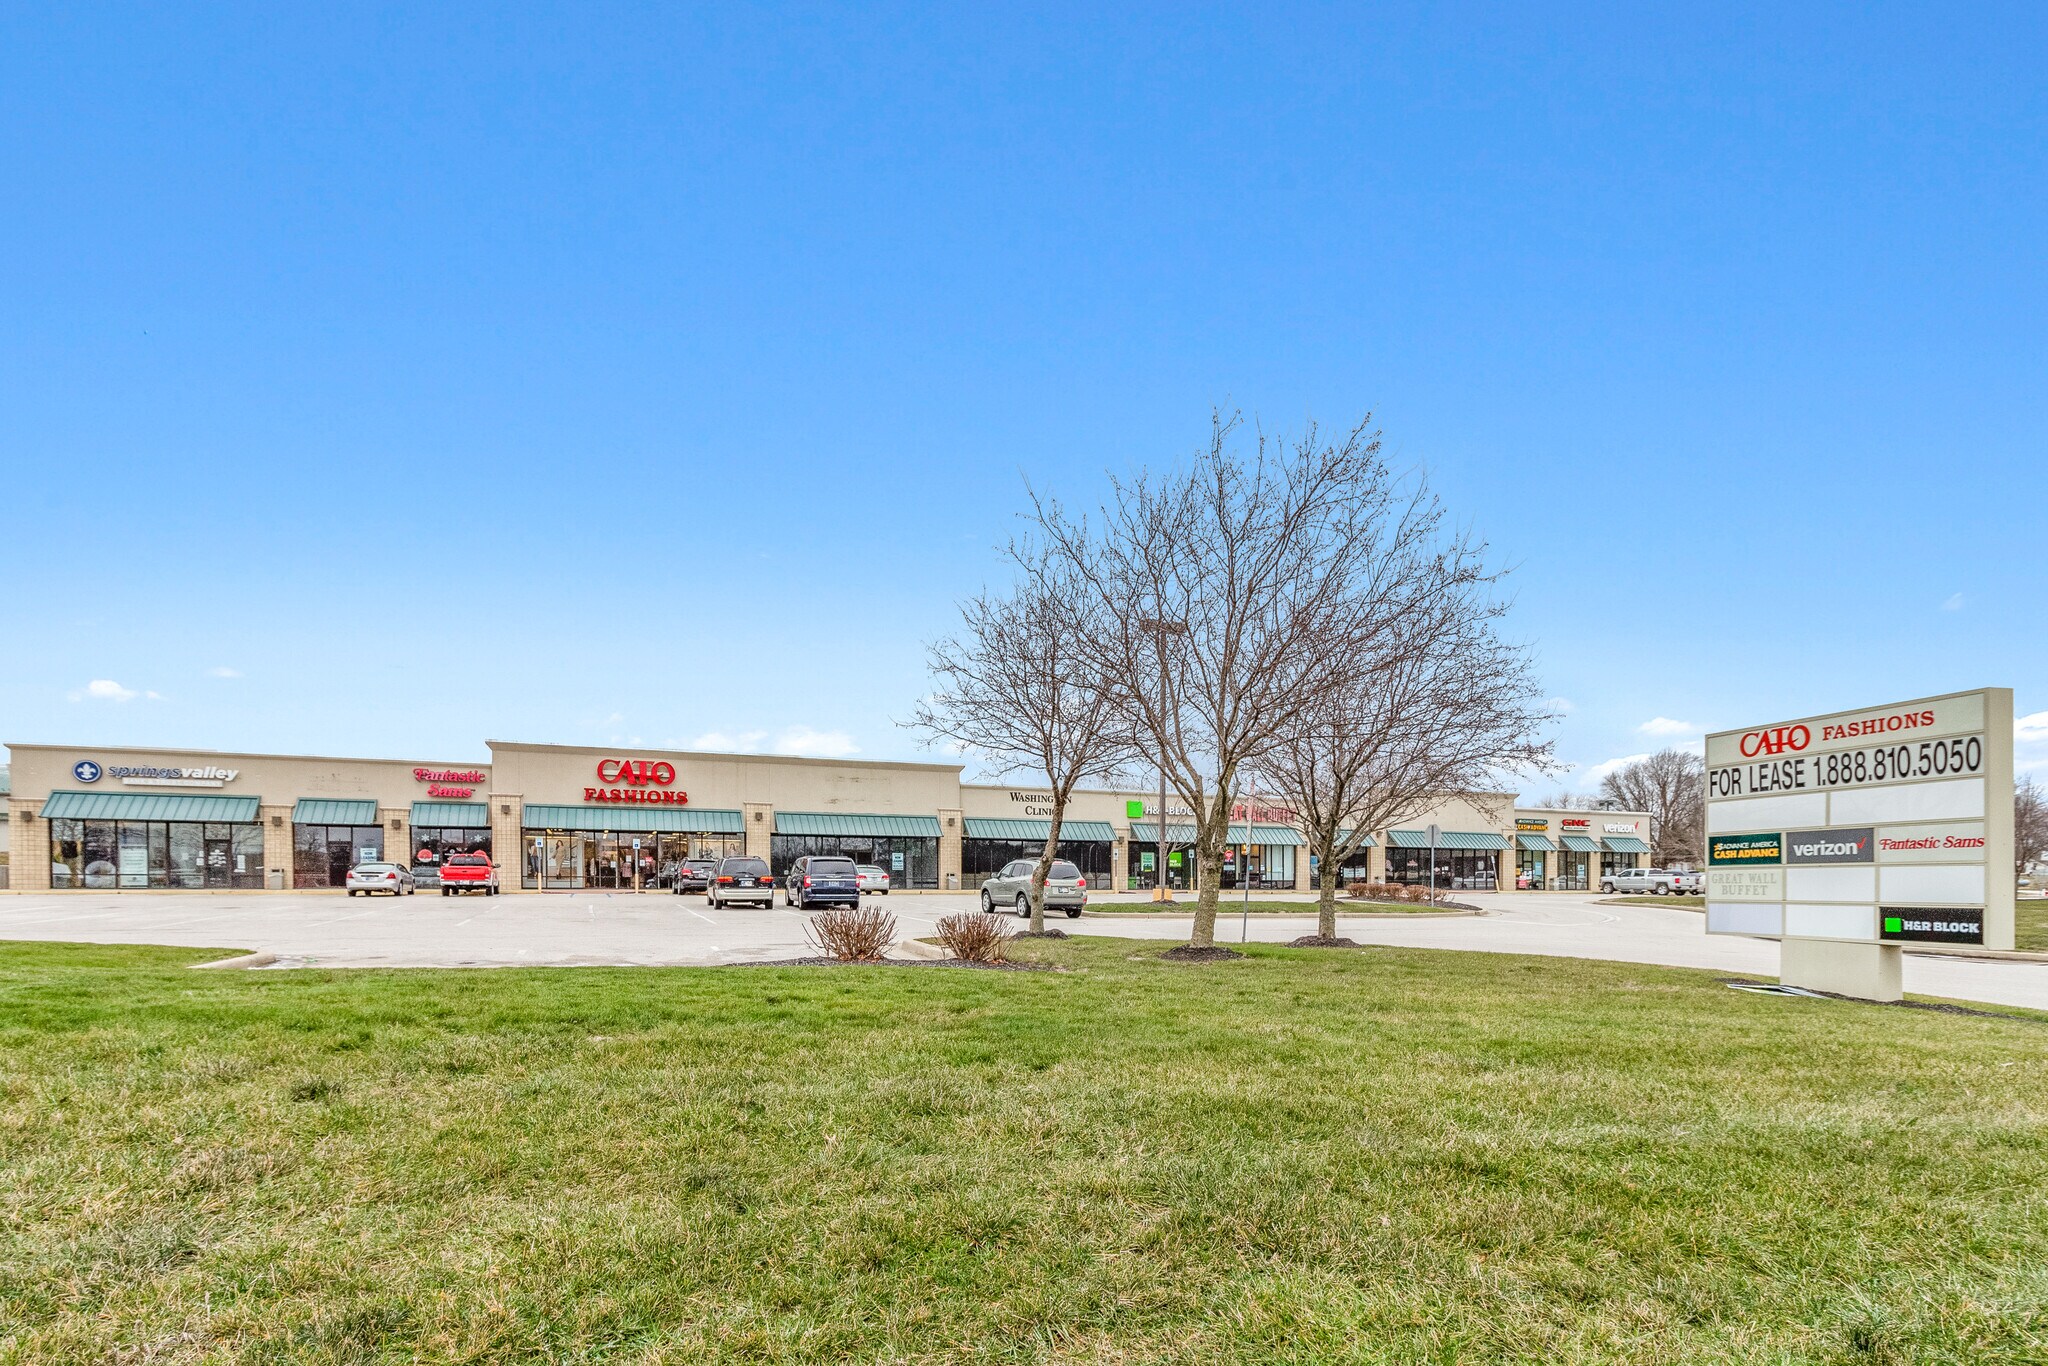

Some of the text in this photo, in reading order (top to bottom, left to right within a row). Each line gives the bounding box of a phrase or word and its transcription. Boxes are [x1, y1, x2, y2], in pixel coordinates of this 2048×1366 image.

[1740, 710, 1935, 758] CATO FASHIONS
[597, 759, 676, 786] CATO
[1709, 736, 1981, 797] FOR LEASE 1.888.810.5050
[413, 768, 486, 783] Fantastic
[427, 783, 472, 798] Sams
[583, 788, 689, 805] FASHIONS
[1009, 791, 1072, 804] WASHINGN
[1145, 805, 1195, 816] H& BLOC
[1562, 819, 1591, 827] GNC
[1603, 821, 1635, 833] verizon
[1724, 841, 1778, 850] ADVANCE AMERICA
[1793, 839, 1858, 857] verizon
[1879, 836, 1985, 850] Fantastic Sams
[1714, 848, 1779, 859] CASH ADVANCE
[1712, 873, 1776, 884] GREAT WALL
[1722, 885, 1768, 896] BUFFET
[1903, 920, 1980, 934] H&R BLOCK
